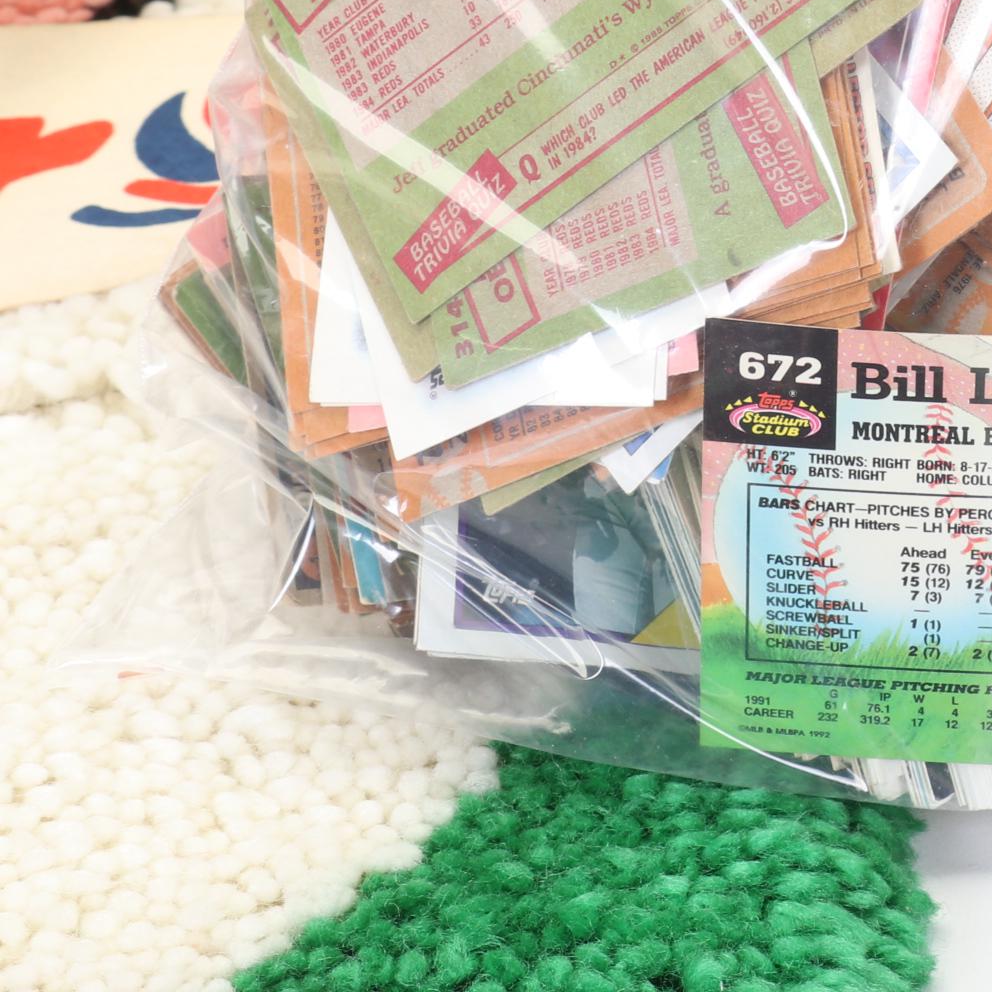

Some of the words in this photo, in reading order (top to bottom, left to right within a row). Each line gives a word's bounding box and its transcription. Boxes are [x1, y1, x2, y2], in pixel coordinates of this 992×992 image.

[315, 15, 342, 39] YEAR
[323, 32, 349, 55] 1980
[347, 2, 387, 36] EUGENE
[328, 44, 354, 67] 1981
[352, 18, 387, 48] TAMPA
[333, 56, 359, 79] 1982
[358, 11, 417, 59] WATERBURY
[339, 68, 365, 91] 1983
[364, 17, 431, 72] INDIANAPOLIS
[370, 60, 398, 84] REDS
[376, 74, 404, 98] REDS
[512, 150, 546, 186] Q
[538, 123, 577, 157] WHICH
[575, 101, 608, 130] CLUB
[605, 85, 629, 107] LED
[628, 69, 652, 91] THE
[649, 27, 707, 75] AMERICAN
[745, 87, 781, 134] QUIZ
[546, 153, 564, 170] IN
[561, 126, 601, 160] 1984?
[736, 106, 797, 207] BASEBALL
[773, 136, 818, 205] TRIVIA
[635, 189, 653, 220] REDS
[655, 180, 672, 207] LEA.
[606, 200, 624, 232] REDS
[713, 200, 731, 219] A
[579, 212, 597, 243] REDS
[662, 207, 682, 246] MAJOR
[413, 220, 469, 283] TRIVIA
[643, 225, 660, 254] 1984
[588, 248, 606, 277] 1980
[615, 238, 632, 266] 1982
[442, 294, 475, 359] 314
[739, 351, 822, 385] 672
[851, 362, 947, 404] Bill
[742, 411, 810, 429] Stadium
[752, 423, 800, 438] CLUB
[852, 422, 975, 446] MONTREAL
[747, 449, 767, 461] HT:
[809, 453, 869, 468] THROWS:
[872, 457, 911, 470] RIGHT
[917, 460, 956, 473] BORN:
[747, 462, 768, 474] WT:
[774, 464, 797, 476] 205
[808, 467, 845, 479] BATS:
[848, 469, 887, 482] RIGHT
[916, 473, 957, 485] HOME:
[758, 497, 800, 511] BARS
[934, 506, 954, 519] BY
[828, 517, 851, 530] RH
[854, 518, 901, 532] Hitters
[923, 522, 943, 534] LH
[947, 523, 992, 537] Hitters
[766, 554, 839, 569] FASTBALL
[900, 546, 947, 560] Ahead
[766, 568, 815, 582] CURVE
[766, 582, 817, 596] SLIDER
[765, 596, 868, 613] KNUCKLEBALL
[765, 610, 854, 626] SCREWBALL
[765, 624, 861, 640] SINKER/SPLIT
[765, 637, 849, 654] CHANGE-UP
[745, 671, 807, 685] MAJOR
[811, 675, 886, 690] LEAGUE
[891, 680, 980, 695] PITCHING
[745, 695, 771, 706] 1991
[744, 707, 794, 719] CAREER
[860, 714, 890, 726] 319.2
[809, 729, 831, 739] 1992
